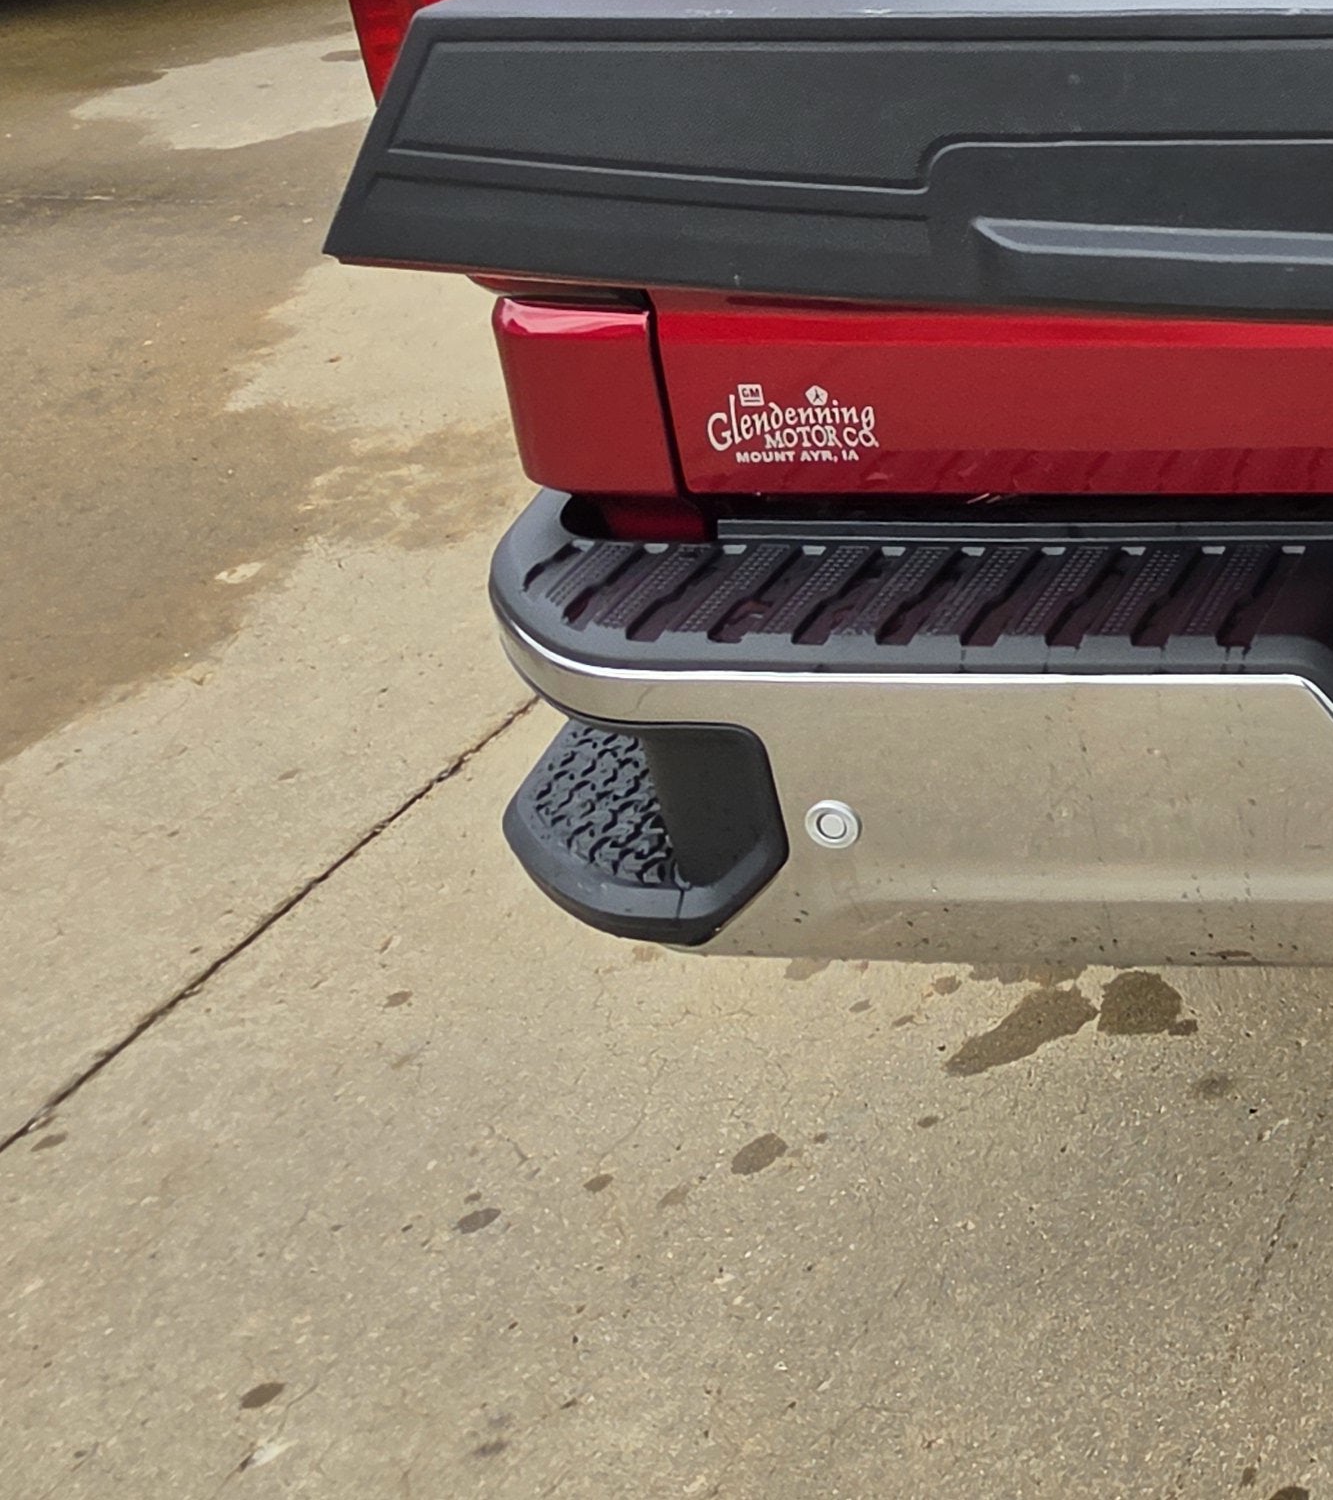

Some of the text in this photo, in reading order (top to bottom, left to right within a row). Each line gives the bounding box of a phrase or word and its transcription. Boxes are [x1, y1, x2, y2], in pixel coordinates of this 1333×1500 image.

[707, 394, 875, 451] Glendenning
[765, 425, 842, 449] MOTOR
[736, 450, 859, 463] MOUNT AYR, IA
